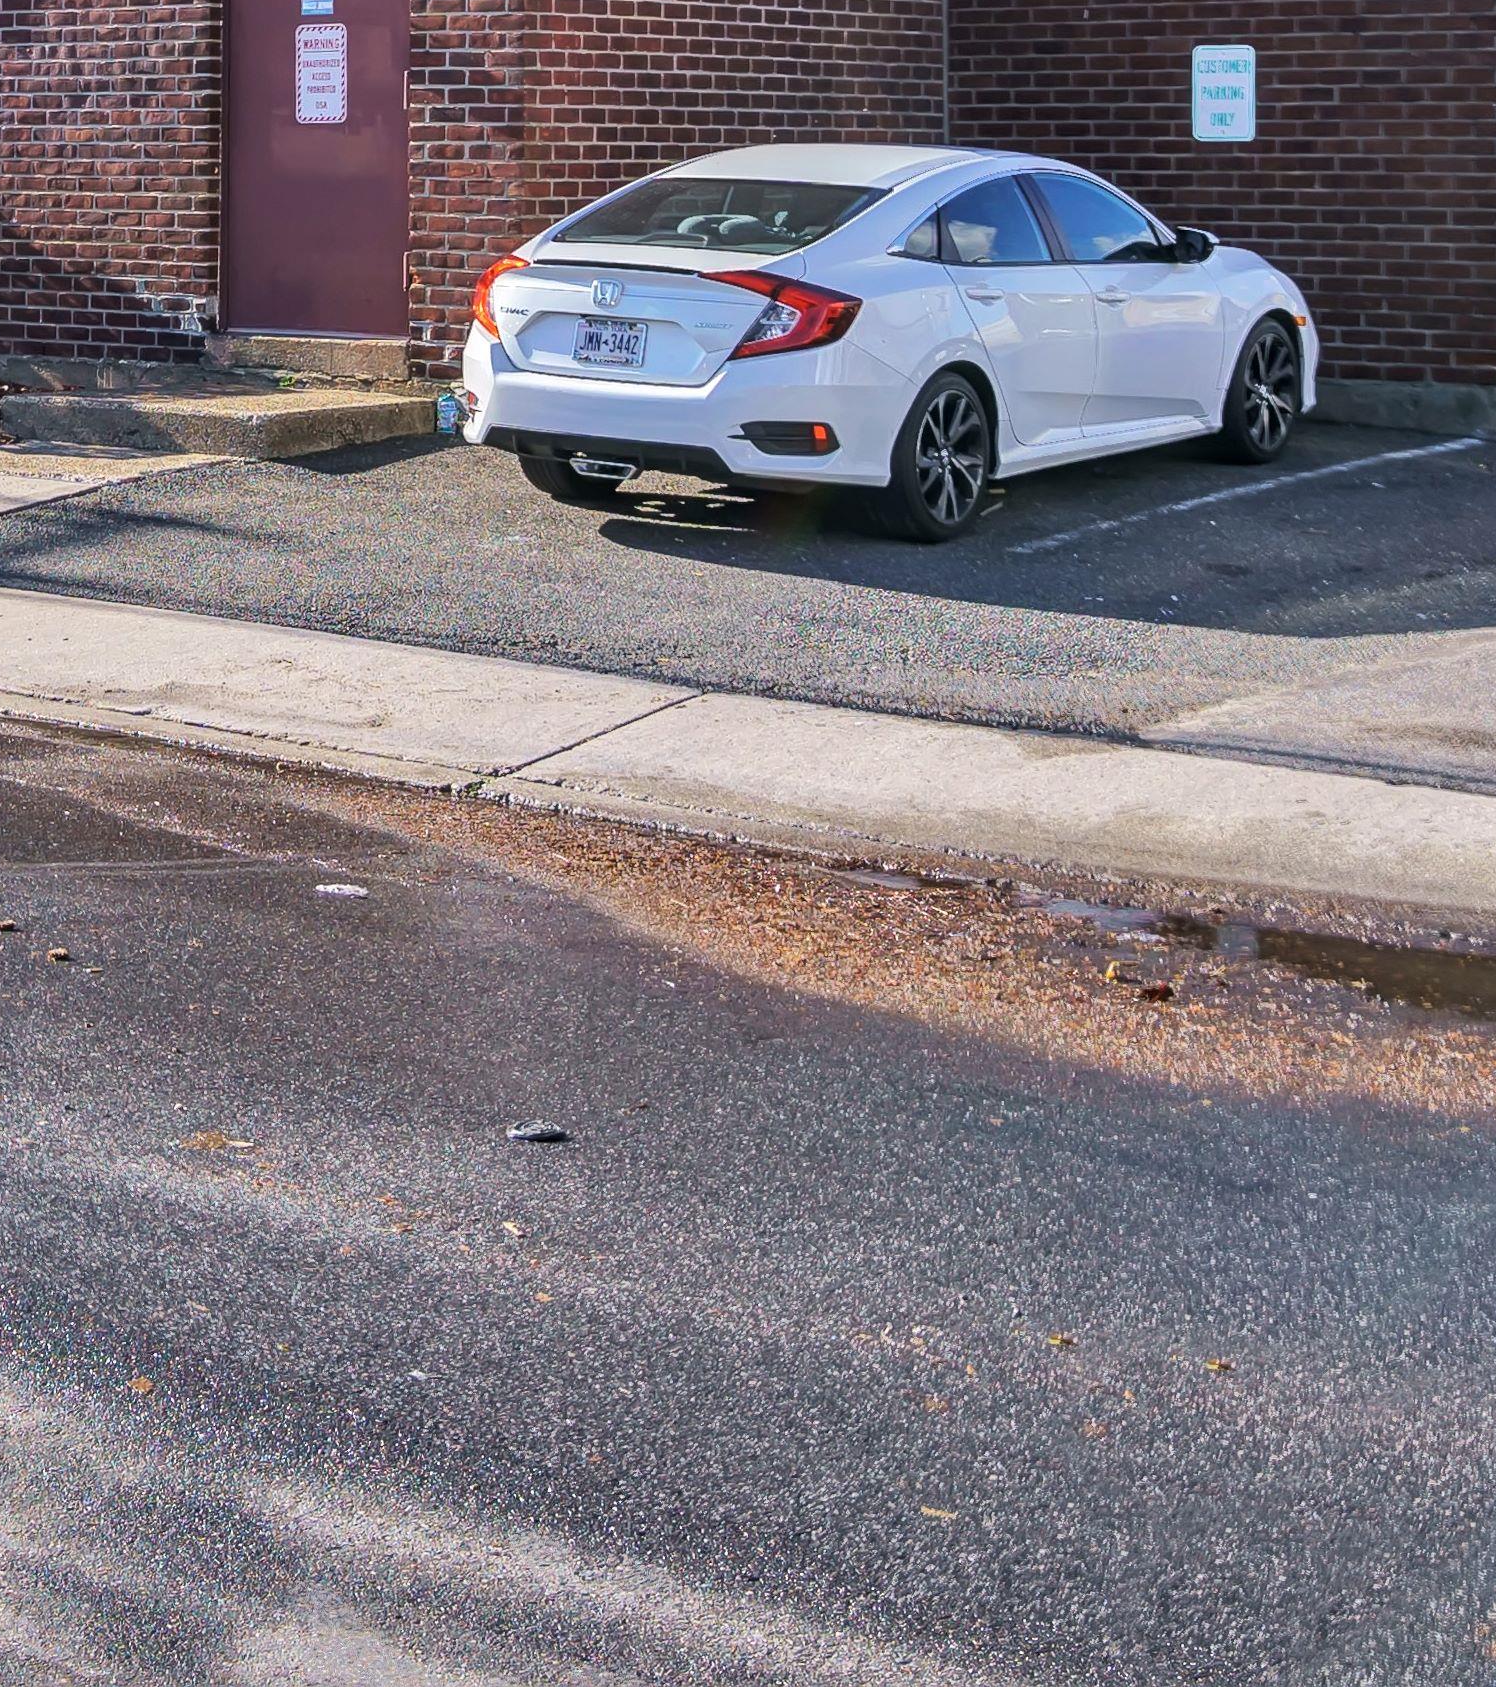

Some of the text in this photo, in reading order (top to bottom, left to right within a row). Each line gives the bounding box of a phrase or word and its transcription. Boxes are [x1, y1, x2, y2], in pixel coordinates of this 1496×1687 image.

[302, 38, 340, 50] WARNING
[1197, 59, 1251, 74] CUSTOMER
[1201, 85, 1246, 101] PARKING
[1210, 112, 1235, 127] ONLY
